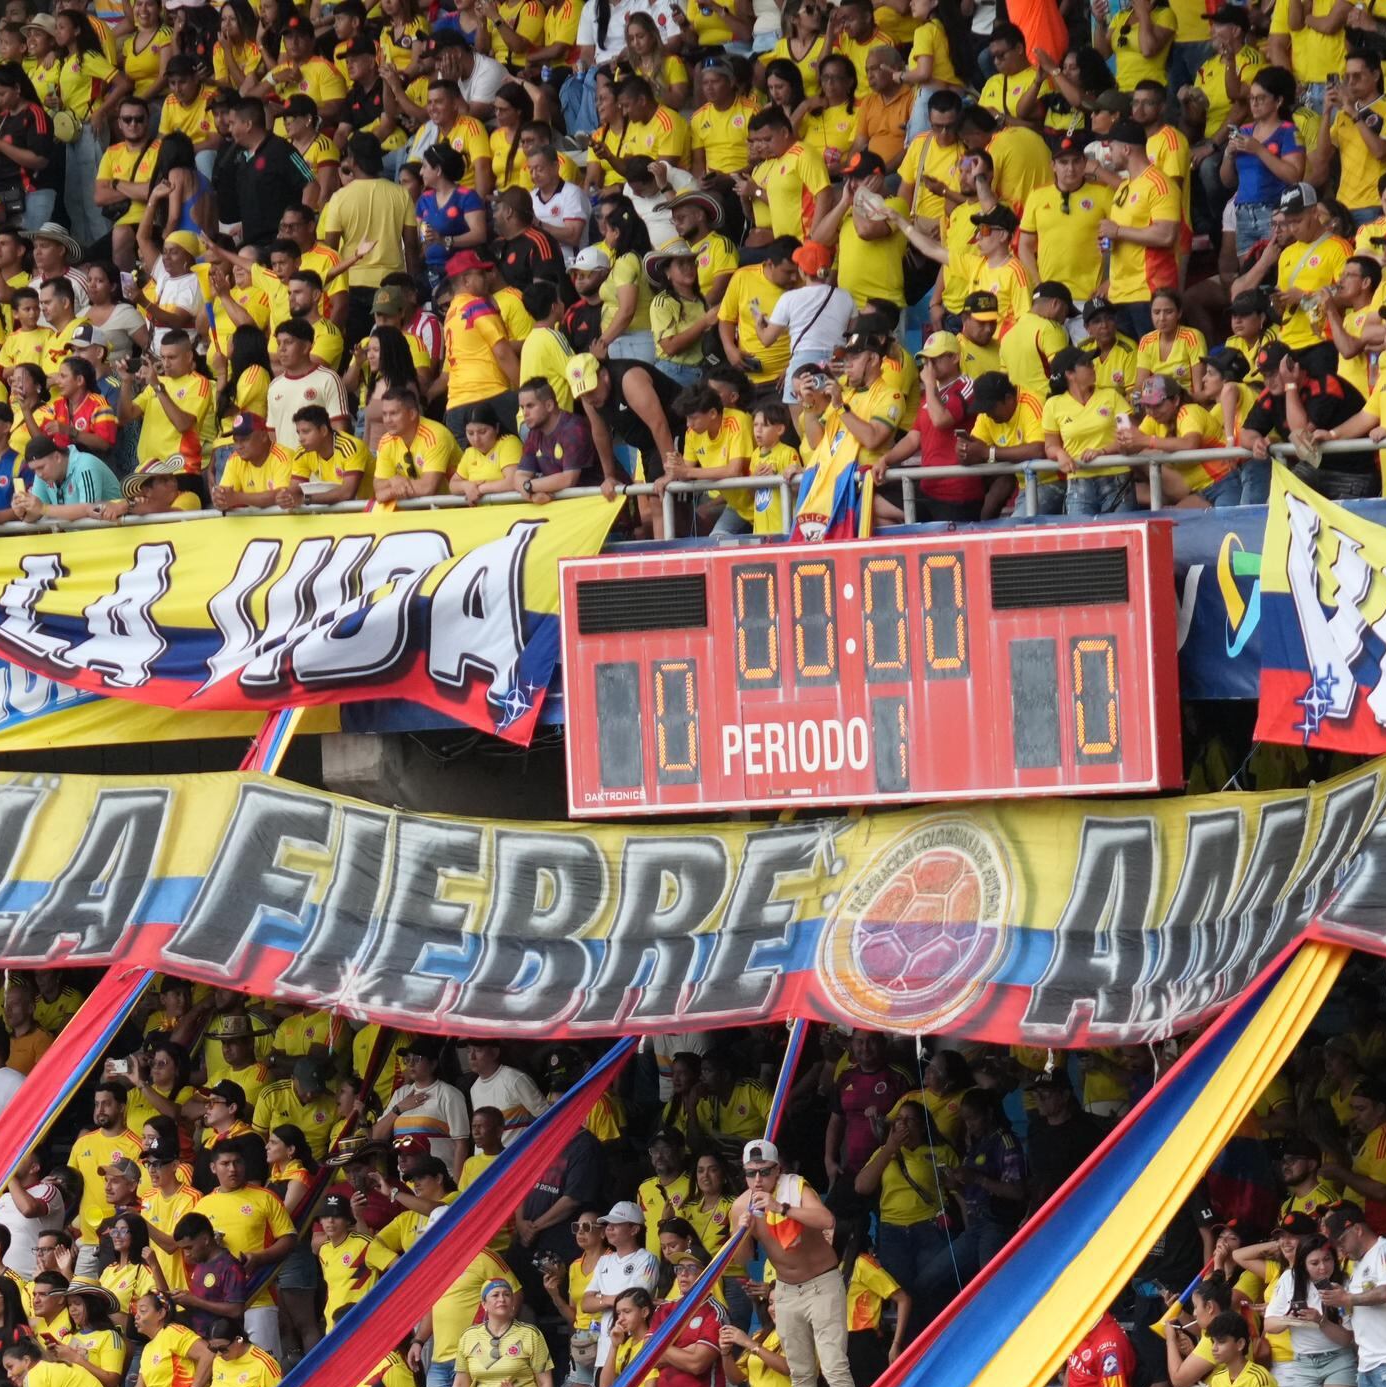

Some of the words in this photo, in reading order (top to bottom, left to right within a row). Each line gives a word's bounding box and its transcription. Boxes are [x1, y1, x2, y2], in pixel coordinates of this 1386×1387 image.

[722, 716, 870, 776] PERIODO
[584, 789, 646, 802] DAKTRONICS
[162, 781, 841, 1030] FIEBRE
